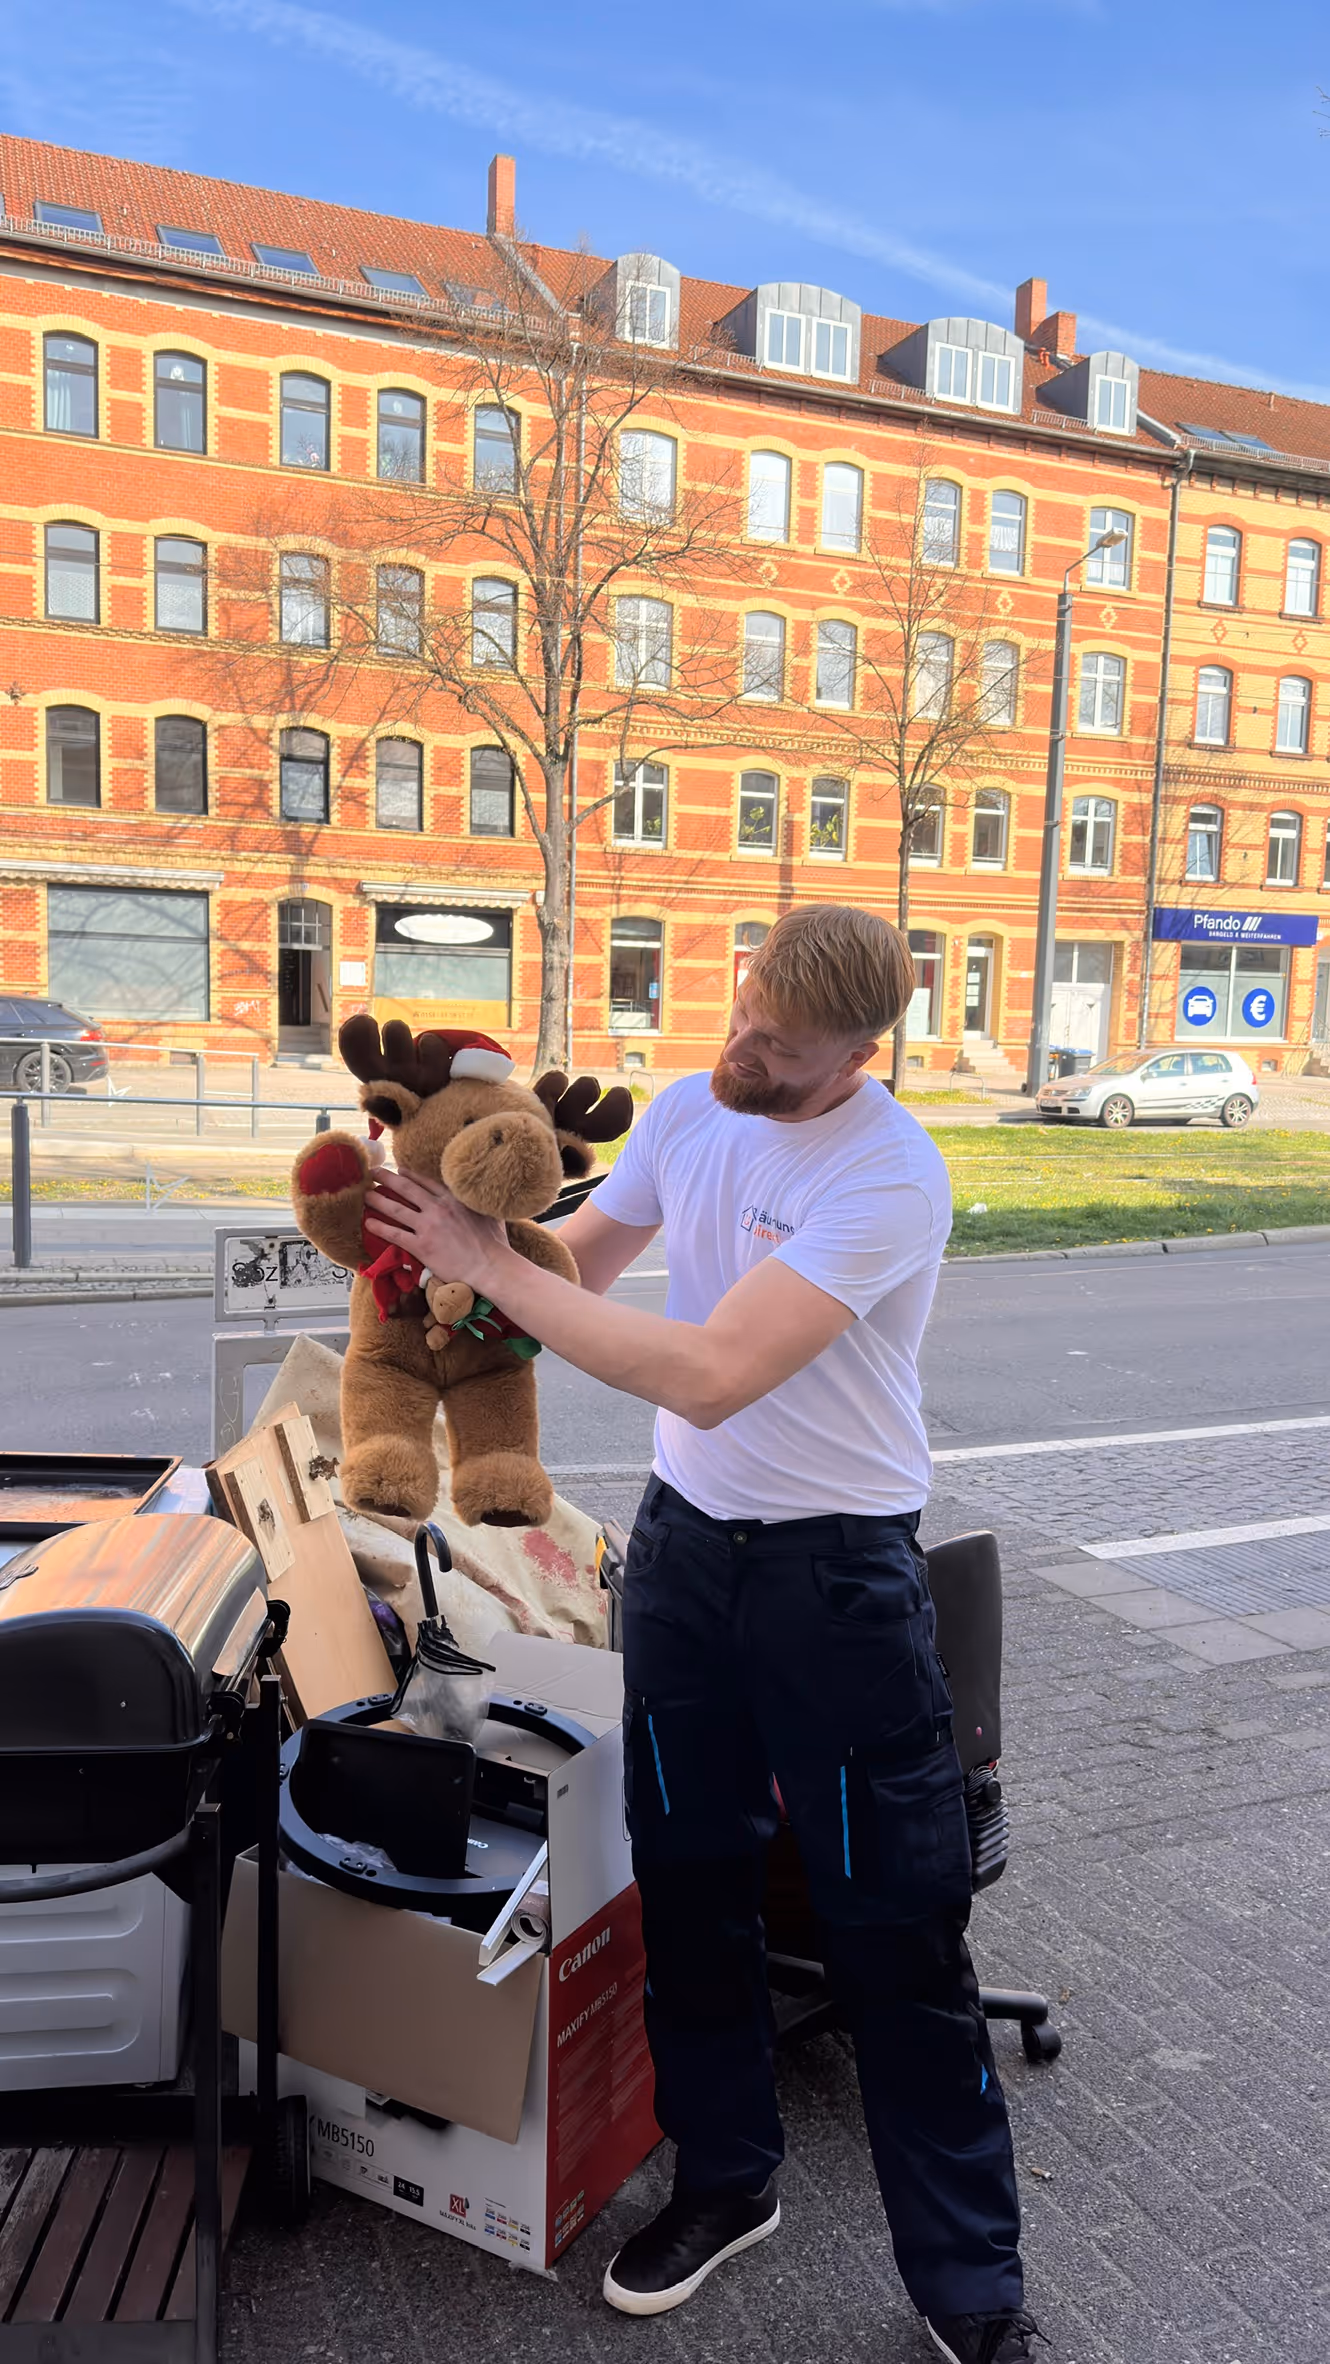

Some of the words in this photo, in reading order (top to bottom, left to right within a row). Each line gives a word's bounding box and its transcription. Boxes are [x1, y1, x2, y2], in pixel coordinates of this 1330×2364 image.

[1193, 914, 1241, 931] Pfando
[559, 1926, 611, 1982] Canon
[557, 2008, 590, 2048] MAXIFY
[590, 1981, 618, 2016] MB5150
[317, 2118, 375, 2157] MB5150
[451, 2197, 465, 2215] XL
